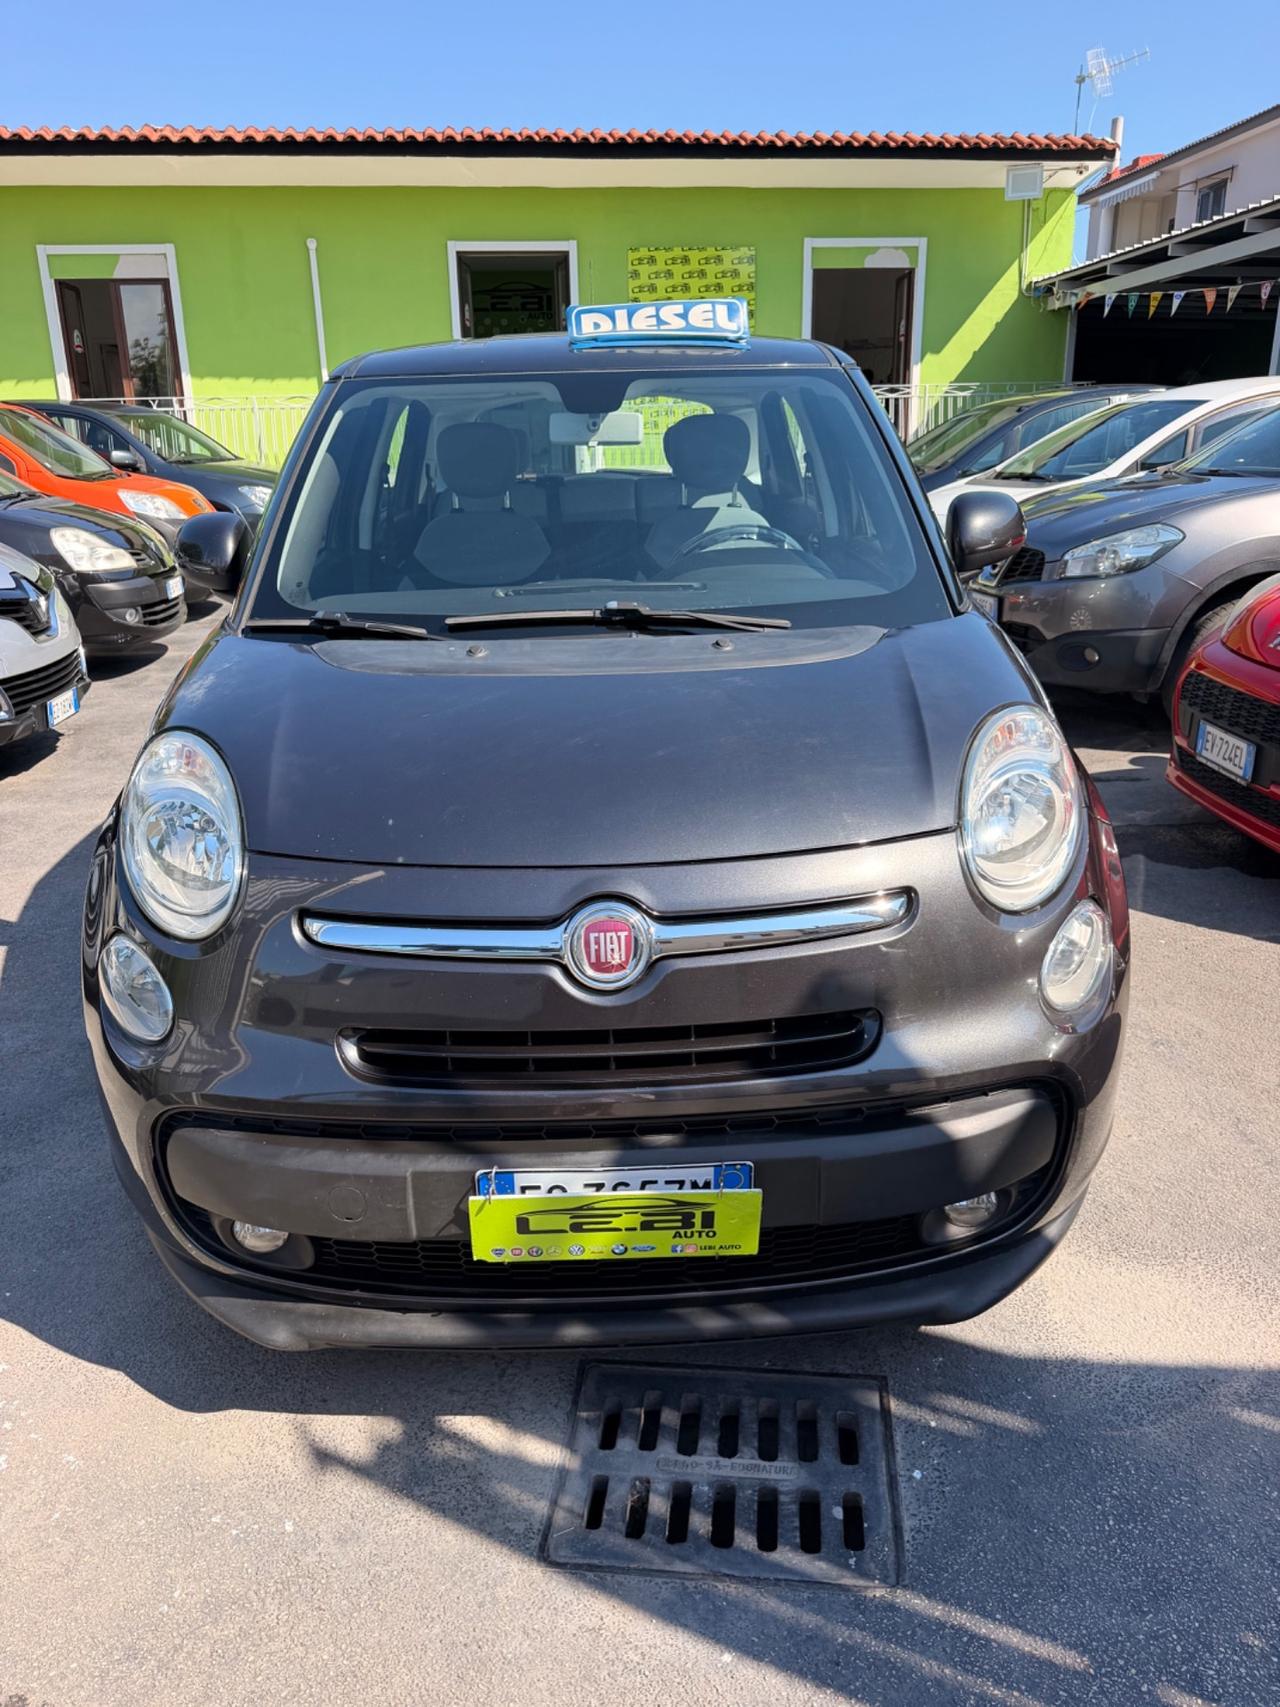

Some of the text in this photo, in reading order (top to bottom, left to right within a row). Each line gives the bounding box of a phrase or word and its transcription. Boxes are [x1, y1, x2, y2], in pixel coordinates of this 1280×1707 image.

[580, 303, 740, 335] DIESEL
[589, 931, 629, 963] FIAT
[672, 1230, 717, 1239] AUTO
